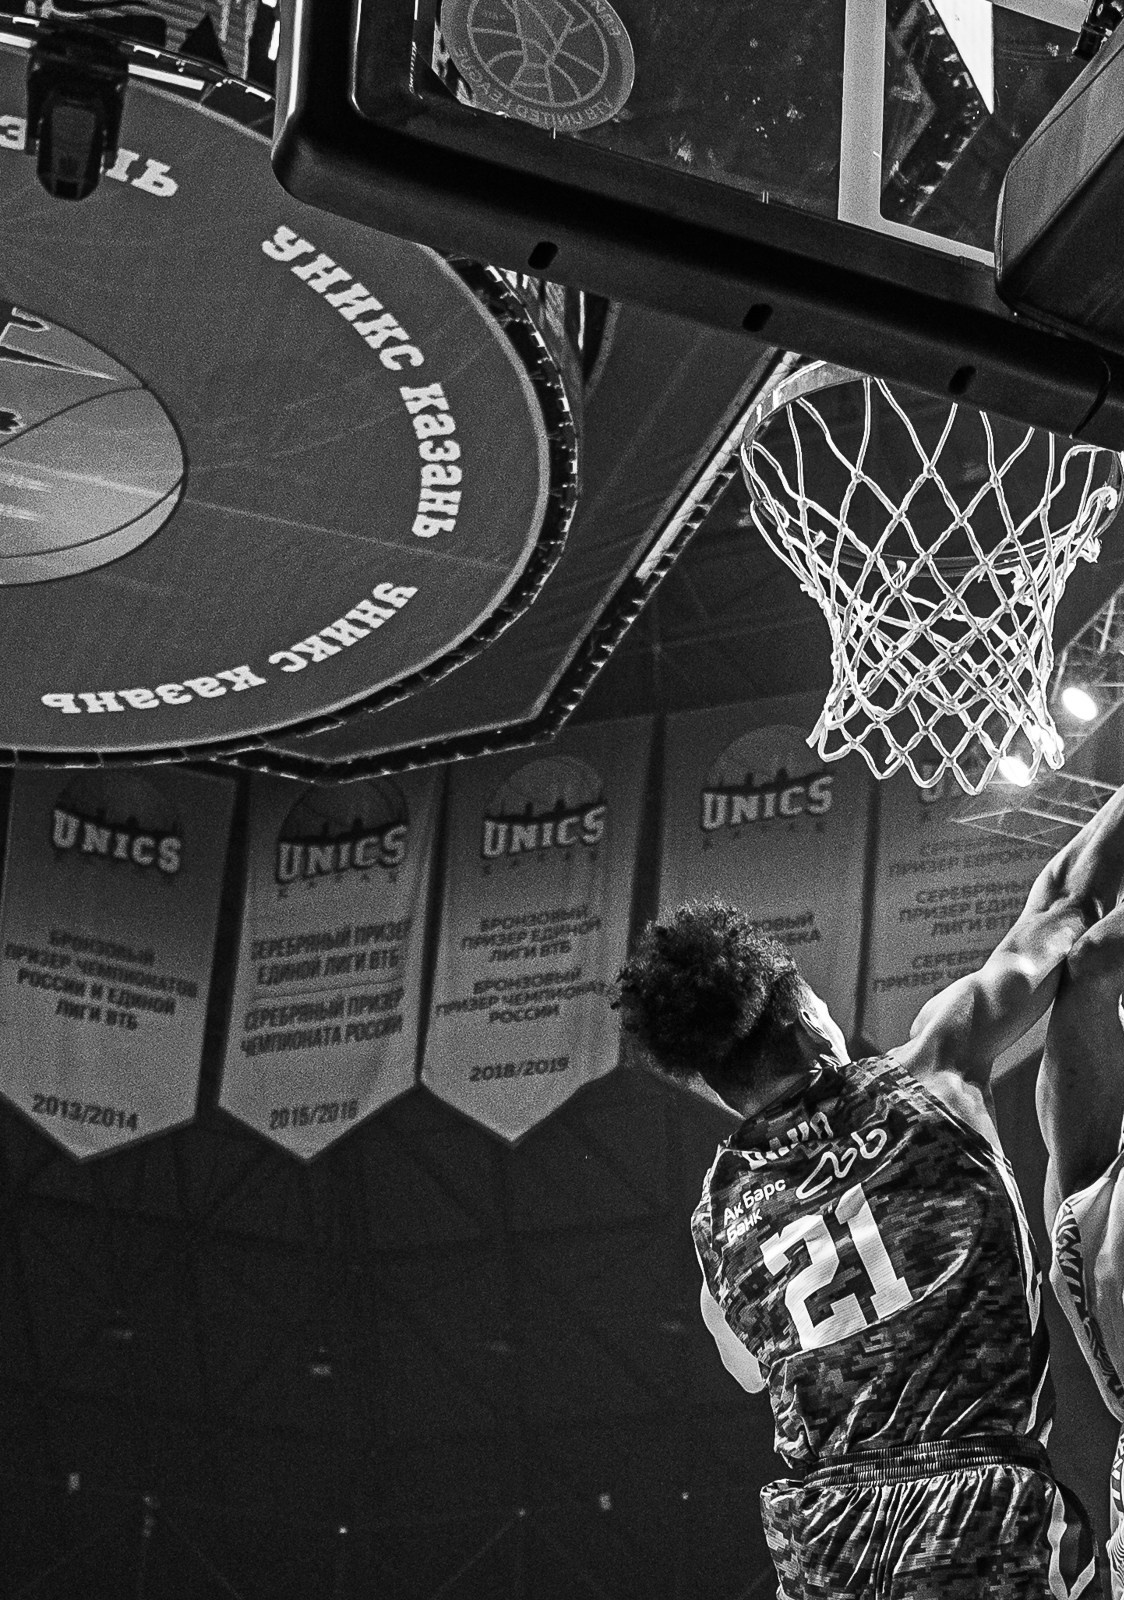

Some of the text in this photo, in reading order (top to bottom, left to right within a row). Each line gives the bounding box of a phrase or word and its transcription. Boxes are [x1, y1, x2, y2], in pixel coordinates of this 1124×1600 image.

[703, 776, 834, 829] UNICS
[52, 808, 181, 874] UNICS
[482, 806, 606, 859] UNICS
[277, 825, 408, 883] UNICS
[480, 904, 590, 932] БРОНЗОВЫЙ
[899, 902, 971, 922] ПРИЗЕР
[931, 918, 982, 937] ЛИГИ
[460, 915, 602, 951] ПРИЗЕР ЕДИНОЙ
[5, 942, 71, 969] ПРИЗЕР
[257, 950, 399, 985] ЕДИНОЙ ЛИГИ ВТБ
[489, 939, 573, 963] ЛИГИ ВТБ
[17, 967, 176, 1016] РОССИИ И ЕДИНОЙ
[473, 967, 582, 995] БРОНЗОВЫЙ
[56, 999, 138, 1031] ЛИГИ ВТБ
[435, 995, 500, 1018] ПРИЗЕР
[489, 1004, 560, 1025] РОССИИ
[469, 1055, 570, 1082] 2018/2019
[32, 1093, 139, 1132] 2013/2014
[270, 1099, 359, 1131] 2015/2016
[723, 1179, 786, 1228] Ак Барс
[725, 1208, 763, 1242] Банк
[759, 1182, 913, 1351] 21
